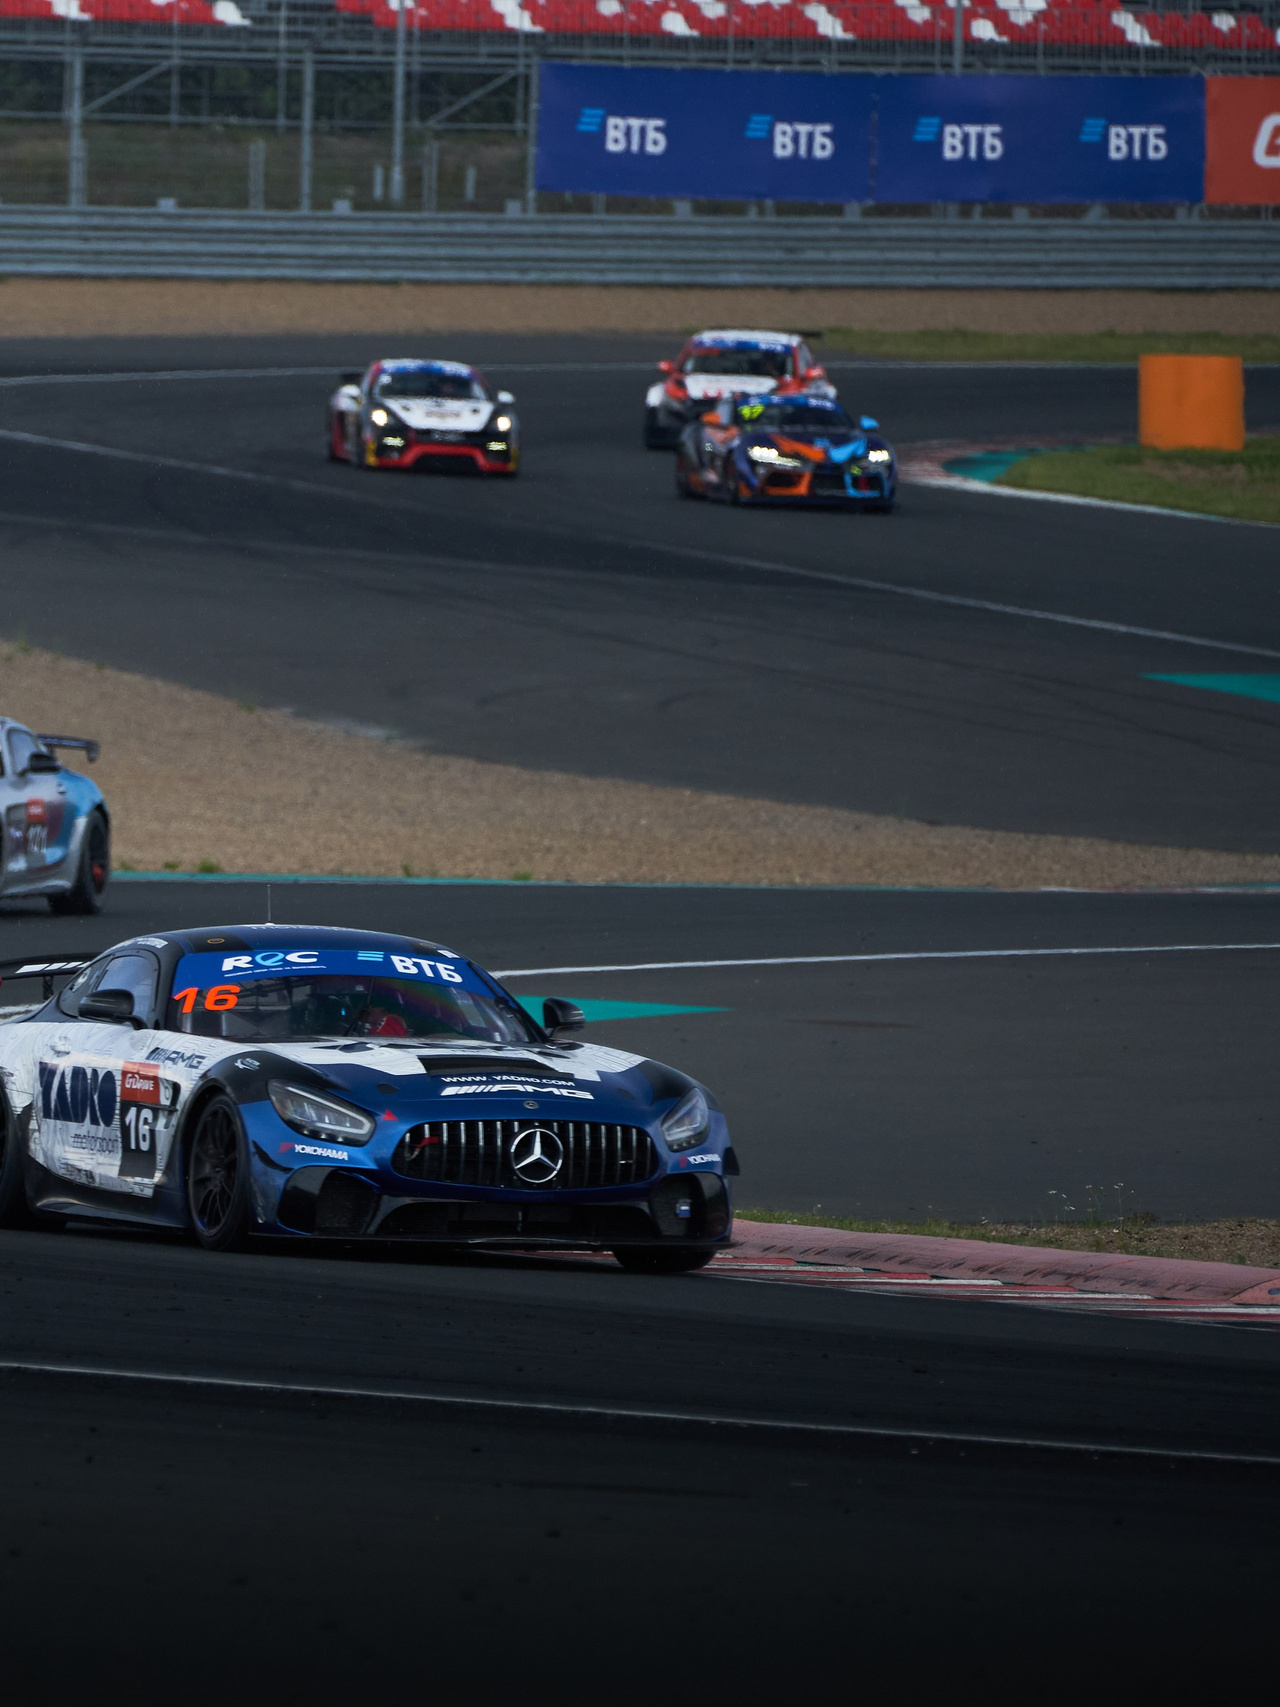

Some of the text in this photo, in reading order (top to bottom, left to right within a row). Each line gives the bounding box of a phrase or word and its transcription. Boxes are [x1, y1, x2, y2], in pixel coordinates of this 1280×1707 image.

[605, 116, 667, 155] ВТБ
[773, 121, 834, 160] ВТБ
[942, 124, 1003, 161] ВТБ
[1108, 125, 1167, 161] ВТБ
[389, 955, 463, 983] ВТБ
[173, 985, 241, 1014] 16
[124, 1105, 153, 1152] 16
[294, 1144, 349, 1161] YOKOHAMA
